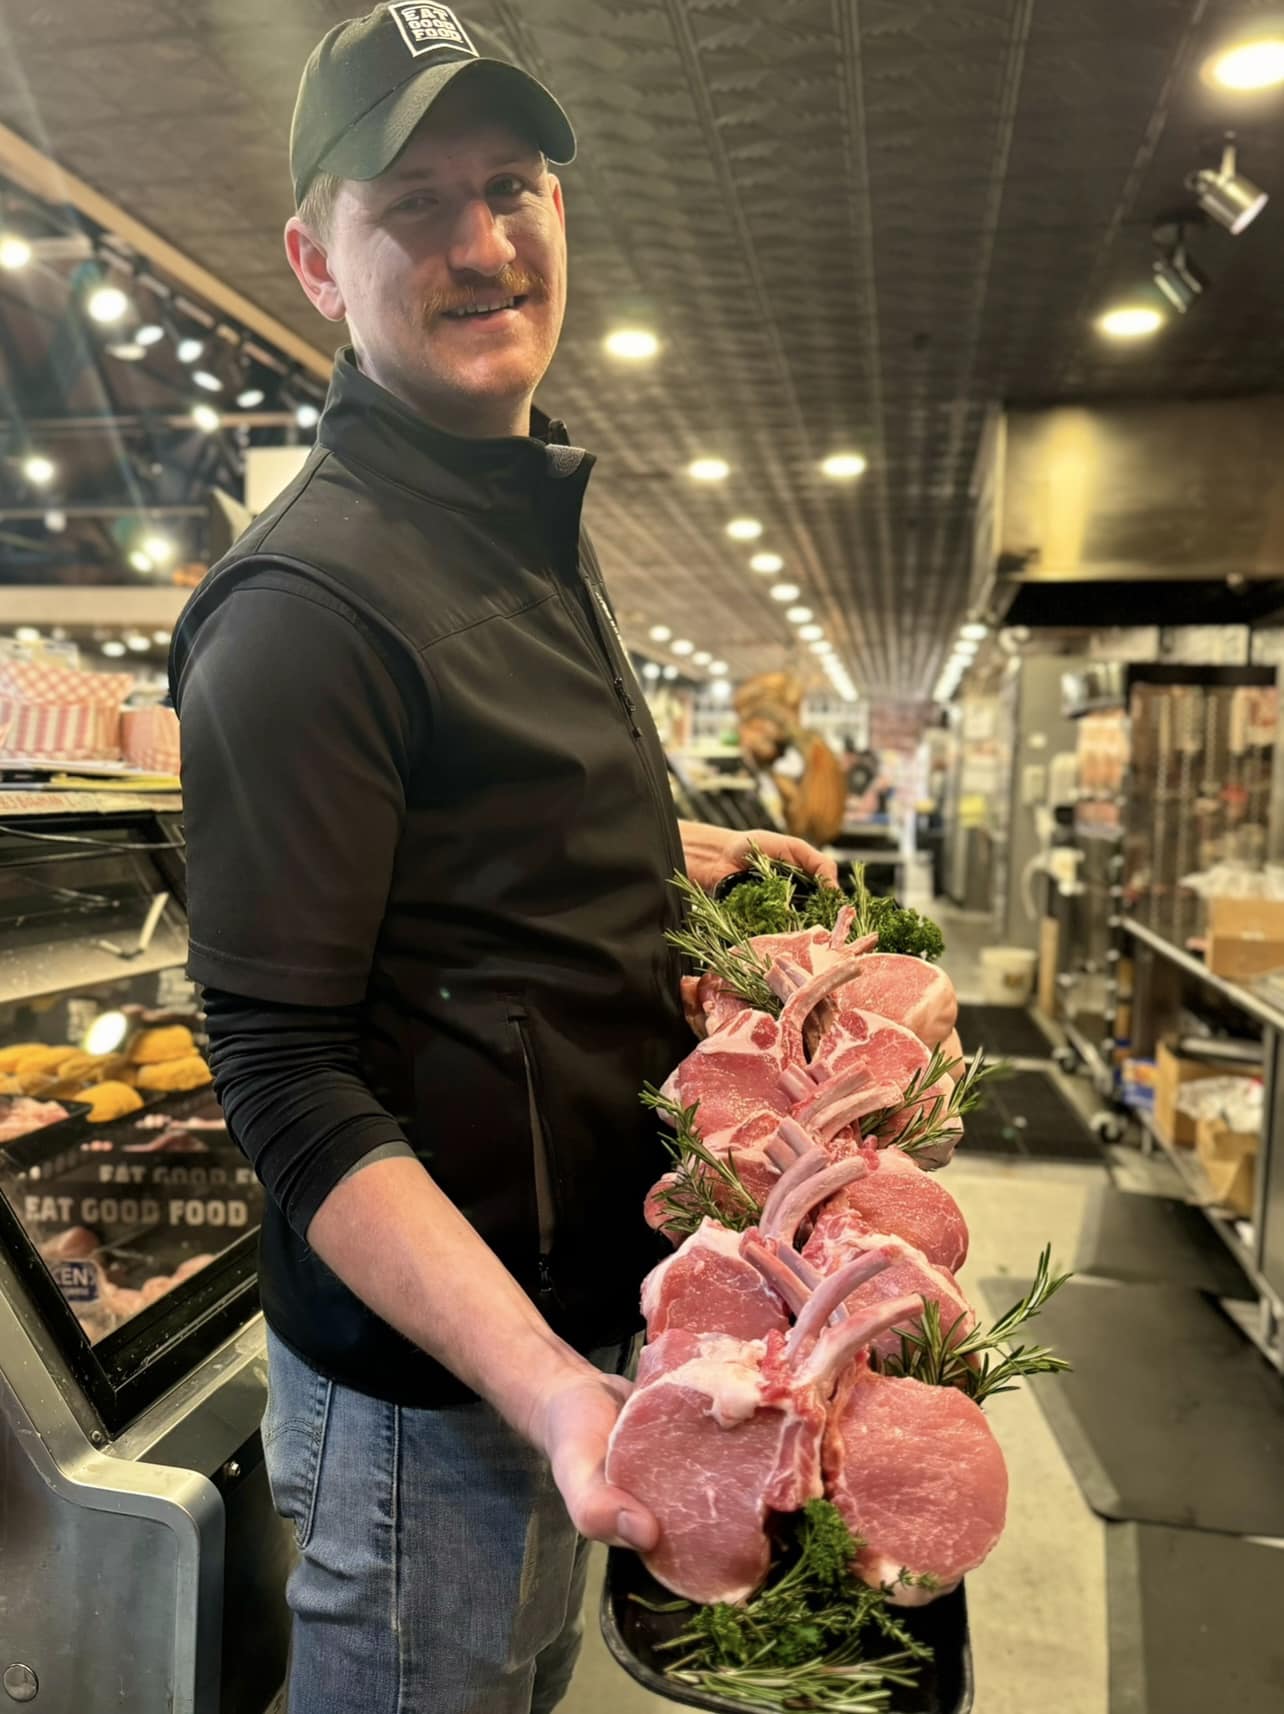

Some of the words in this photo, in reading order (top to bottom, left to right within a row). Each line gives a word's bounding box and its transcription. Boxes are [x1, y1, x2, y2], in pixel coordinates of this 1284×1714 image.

[401, 6, 448, 21] EAT
[408, 19, 456, 30] GOOD
[412, 28, 464, 43] FOOD
[25, 1195, 74, 1222] EAT
[82, 1197, 160, 1225] GOOD
[169, 1199, 248, 1227] FOOD
